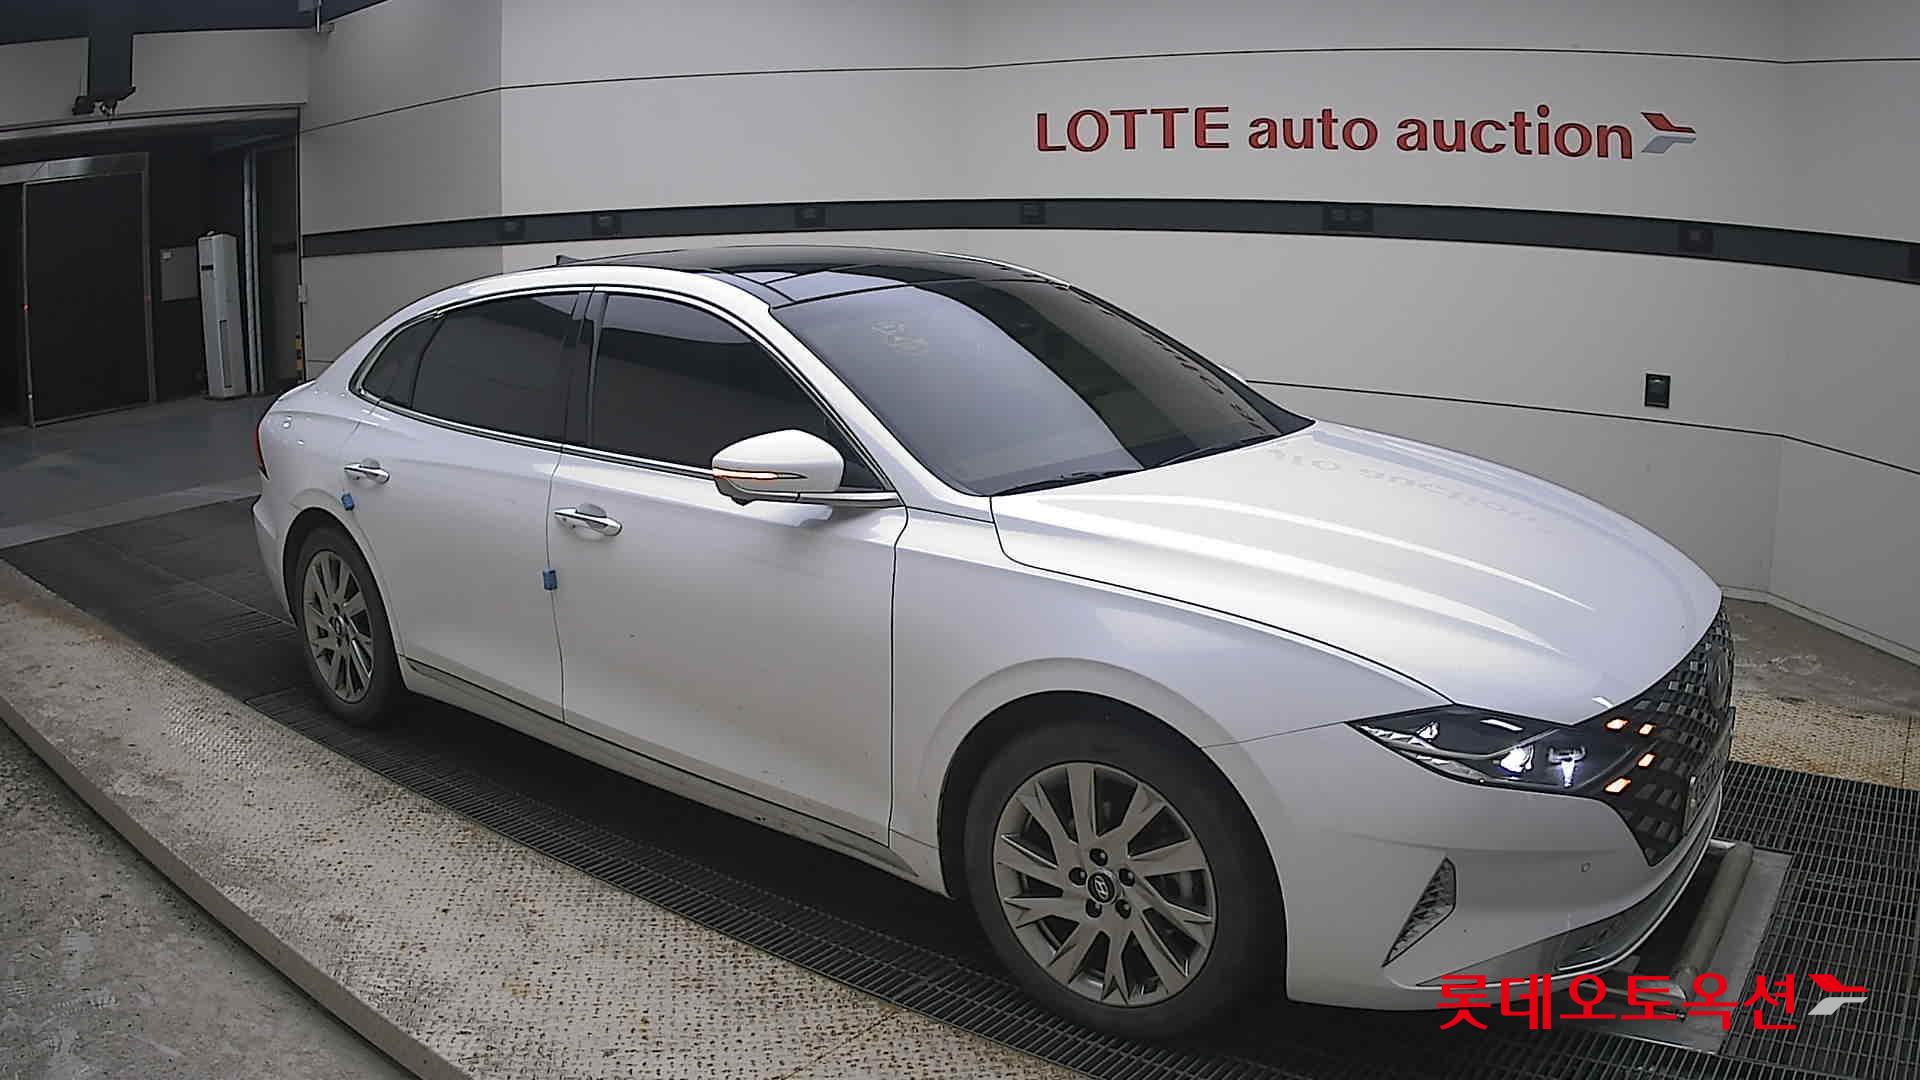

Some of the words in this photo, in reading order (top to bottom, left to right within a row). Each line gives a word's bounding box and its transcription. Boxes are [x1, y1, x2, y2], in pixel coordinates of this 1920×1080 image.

[1037, 106, 1230, 152] LOTTE
[1248, 108, 1378, 150] auto
[1397, 104, 1633, 159] auction
